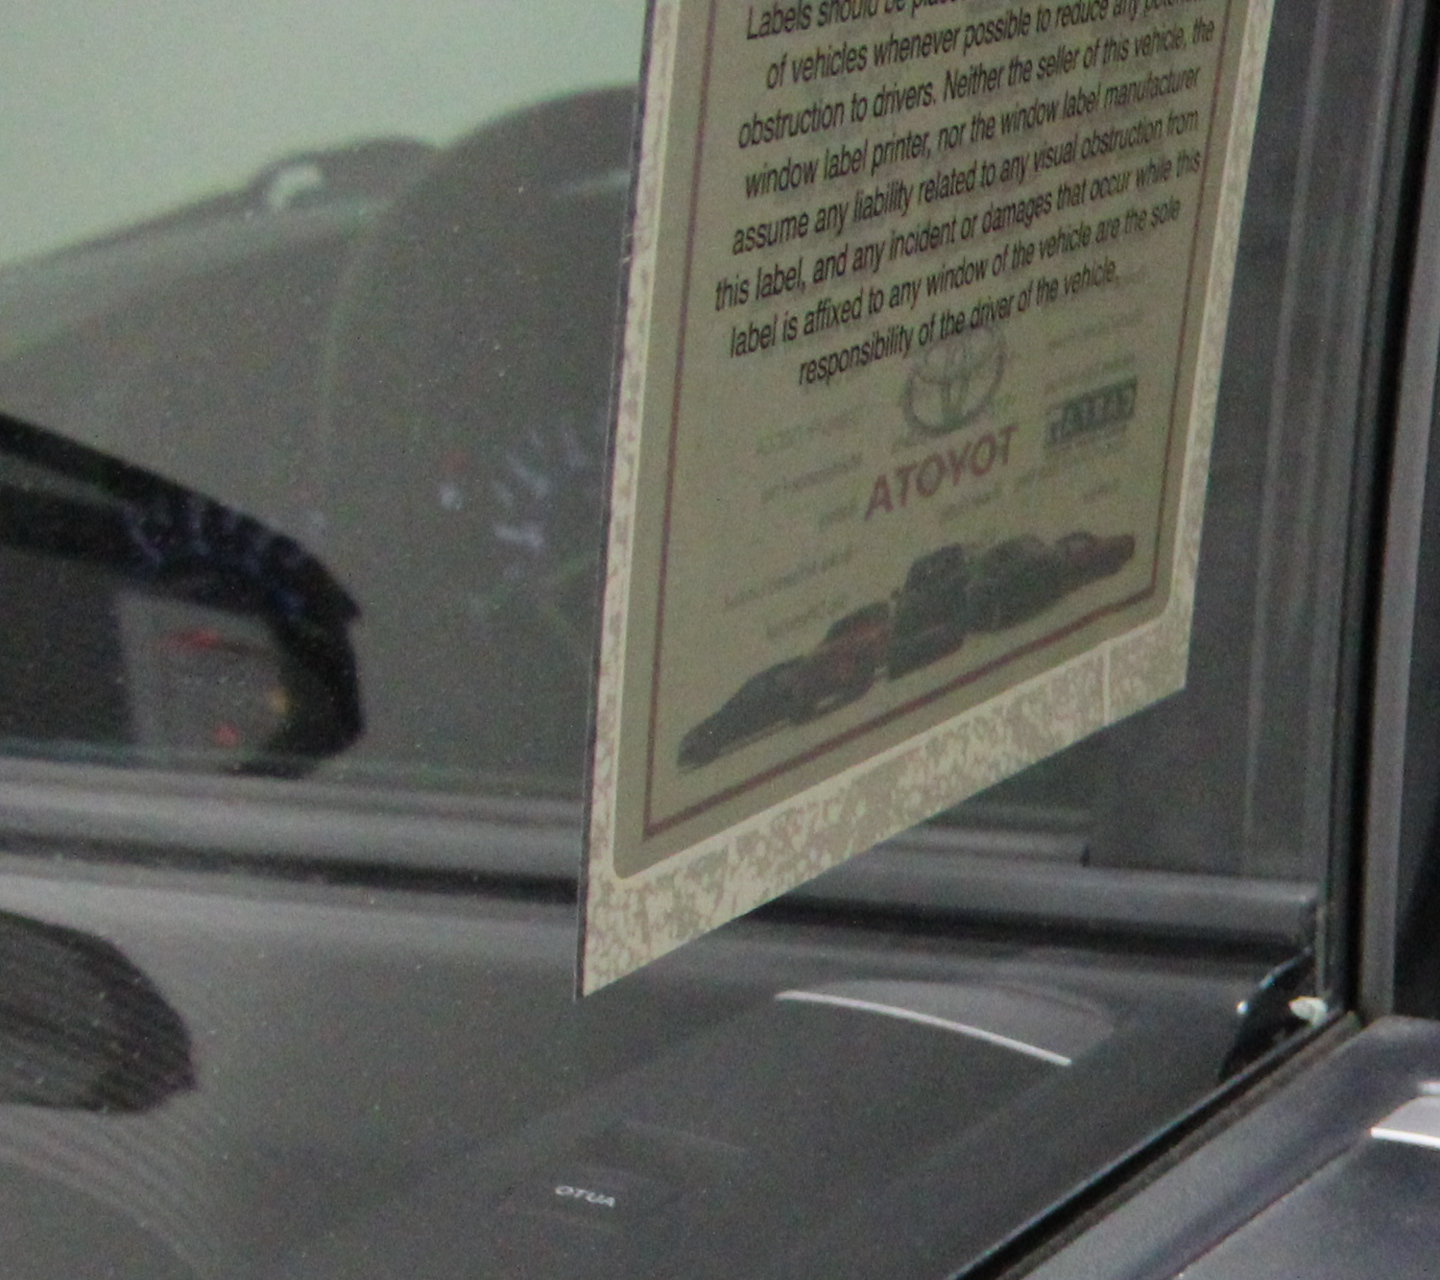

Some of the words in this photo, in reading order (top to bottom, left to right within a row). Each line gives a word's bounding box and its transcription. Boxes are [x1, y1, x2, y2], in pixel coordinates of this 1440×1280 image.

[739, 101, 844, 148] obstruction
[851, 93, 867, 122] to
[943, 62, 1004, 102] Neither
[1007, 56, 1033, 87] the
[1036, 50, 1079, 80] seller
[1083, 39, 1101, 69] of
[1102, 35, 1129, 65] this
[1192, 17, 1215, 45] the
[747, 0, 812, 40] Labels
[767, 52, 787, 89] of
[792, 41, 867, 83] vehicles
[874, 26, 960, 66] whenever
[963, 8, 1031, 56] possible
[1036, 3, 1052, 31] to
[1054, 0, 1108, 29] reduce
[732, 212, 809, 256] assume
[815, 201, 849, 237] any
[853, 180, 914, 222] liability
[919, 161, 977, 203] related
[980, 160, 996, 188] to
[1000, 151, 1028, 184] any
[1033, 133, 1077, 172] visual
[1081, 118, 1163, 159] obstruction
[1166, 108, 1199, 137] from
[745, 156, 819, 198] window
[823, 138, 868, 181] label
[937, 120, 967, 151] nor
[970, 112, 996, 142] the
[1001, 97, 1059, 135] window
[1062, 84, 1101, 117] label
[1104, 66, 1200, 109] manufacturer
[715, 274, 750, 311] this
[812, 243, 848, 284] and
[852, 240, 886, 273] any
[889, 214, 956, 261] incident
[960, 212, 978, 240] or
[982, 192, 1052, 234] damages
[1057, 179, 1086, 210] that
[1089, 170, 1132, 201] occur
[1135, 156, 1172, 187] while
[1176, 149, 1200, 178] this
[730, 314, 778, 358] label
[782, 310, 798, 343] is
[803, 287, 864, 336] affixed
[868, 285, 884, 315] to
[889, 277, 922, 310] any
[926, 255, 989, 297] window
[991, 244, 1010, 277] of
[1011, 239, 1035, 269] the
[1039, 220, 1092, 260] vehicle
[1095, 216, 1120, 244] are
[1124, 207, 1147, 235] the
[1151, 194, 1182, 228] sole
[799, 323, 913, 386] responsibility
[919, 312, 936, 346] of
[940, 309, 965, 341] the
[970, 293, 1015, 329] driver
[1017, 280, 1034, 312] of
[1036, 274, 1058, 306] the
